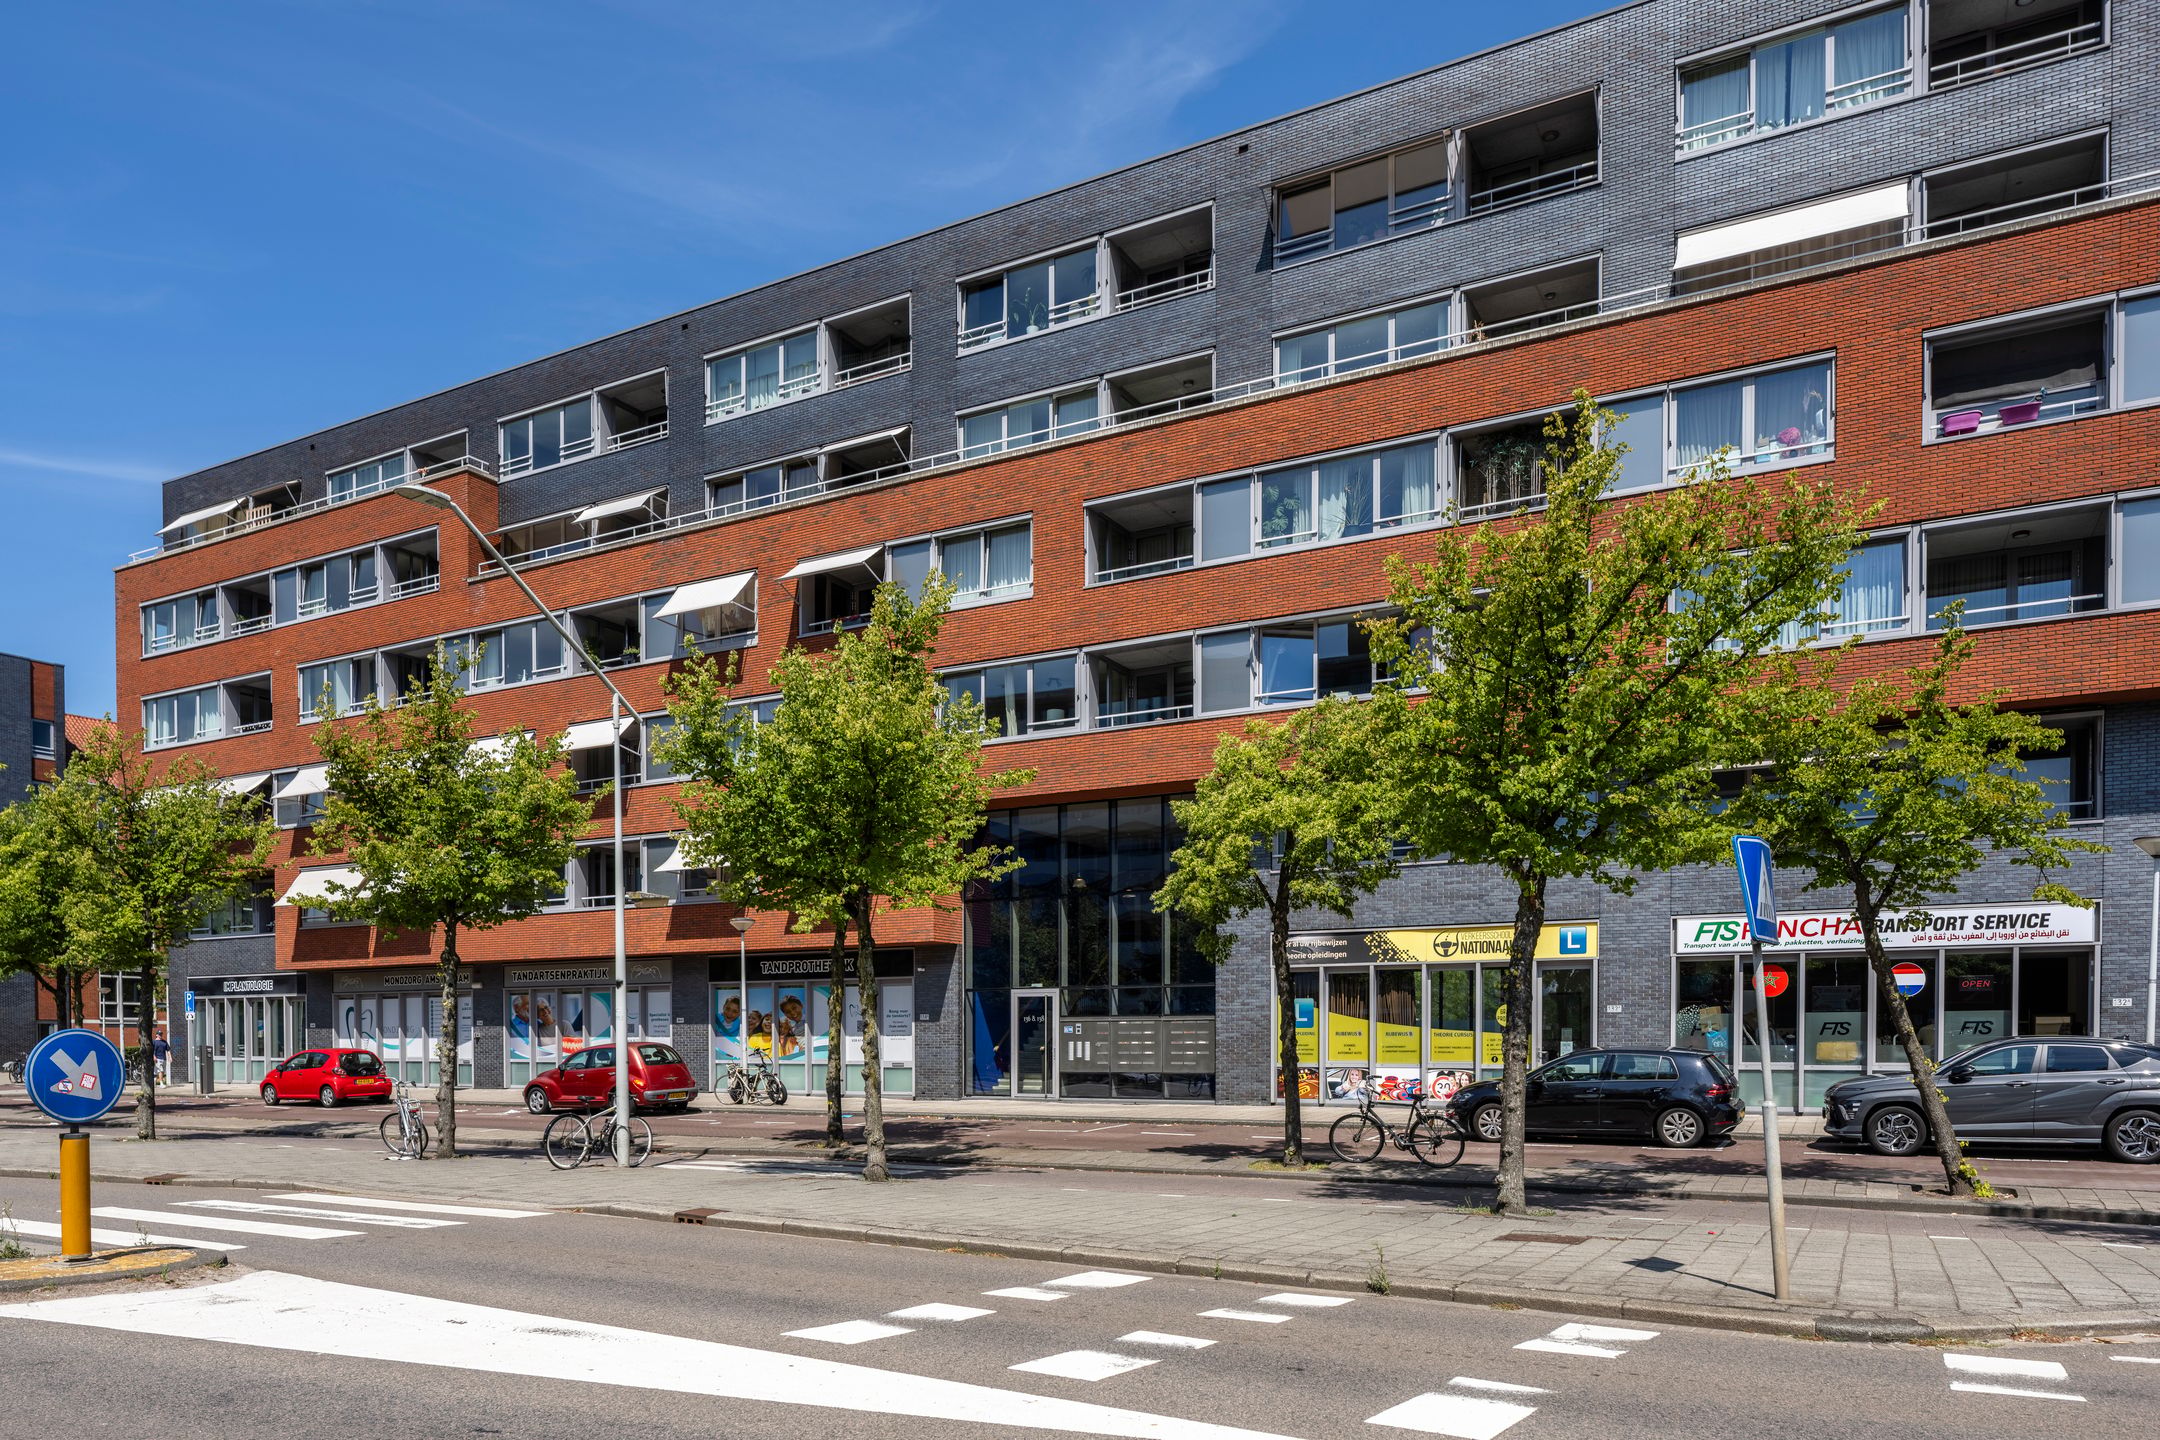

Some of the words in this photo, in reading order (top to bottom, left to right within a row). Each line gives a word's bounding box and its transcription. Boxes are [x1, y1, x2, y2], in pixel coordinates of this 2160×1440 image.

[1876, 915, 1968, 933] RANSPORT
[1973, 913, 2051, 929] SERVICE
[1694, 920, 1740, 942] FTS
[1986, 931, 1997, 941] إلى
[2018, 931, 2029, 939] من
[2030, 929, 2055, 939] البضائع
[2055, 929, 2070, 937] نقل
[1567, 932, 1581, 949] L
[1912, 933, 1927, 942] أمان
[1933, 933, 1946, 941] ثقة
[1948, 933, 1960, 941] بكل
[1311, 938, 1348, 947] rijbewijzen
[1307, 952, 1347, 960] opleidingen
[511, 967, 609, 982] TANDARTSENPRAKTIJK
[383, 975, 423, 986] MONDZORG
[1961, 980, 1991, 988] OPEN
[223, 980, 274, 992] IMPLANTOLOGIE
[1820, 1021, 1852, 1036] FTS
[1960, 1020, 1994, 1035] FTS
